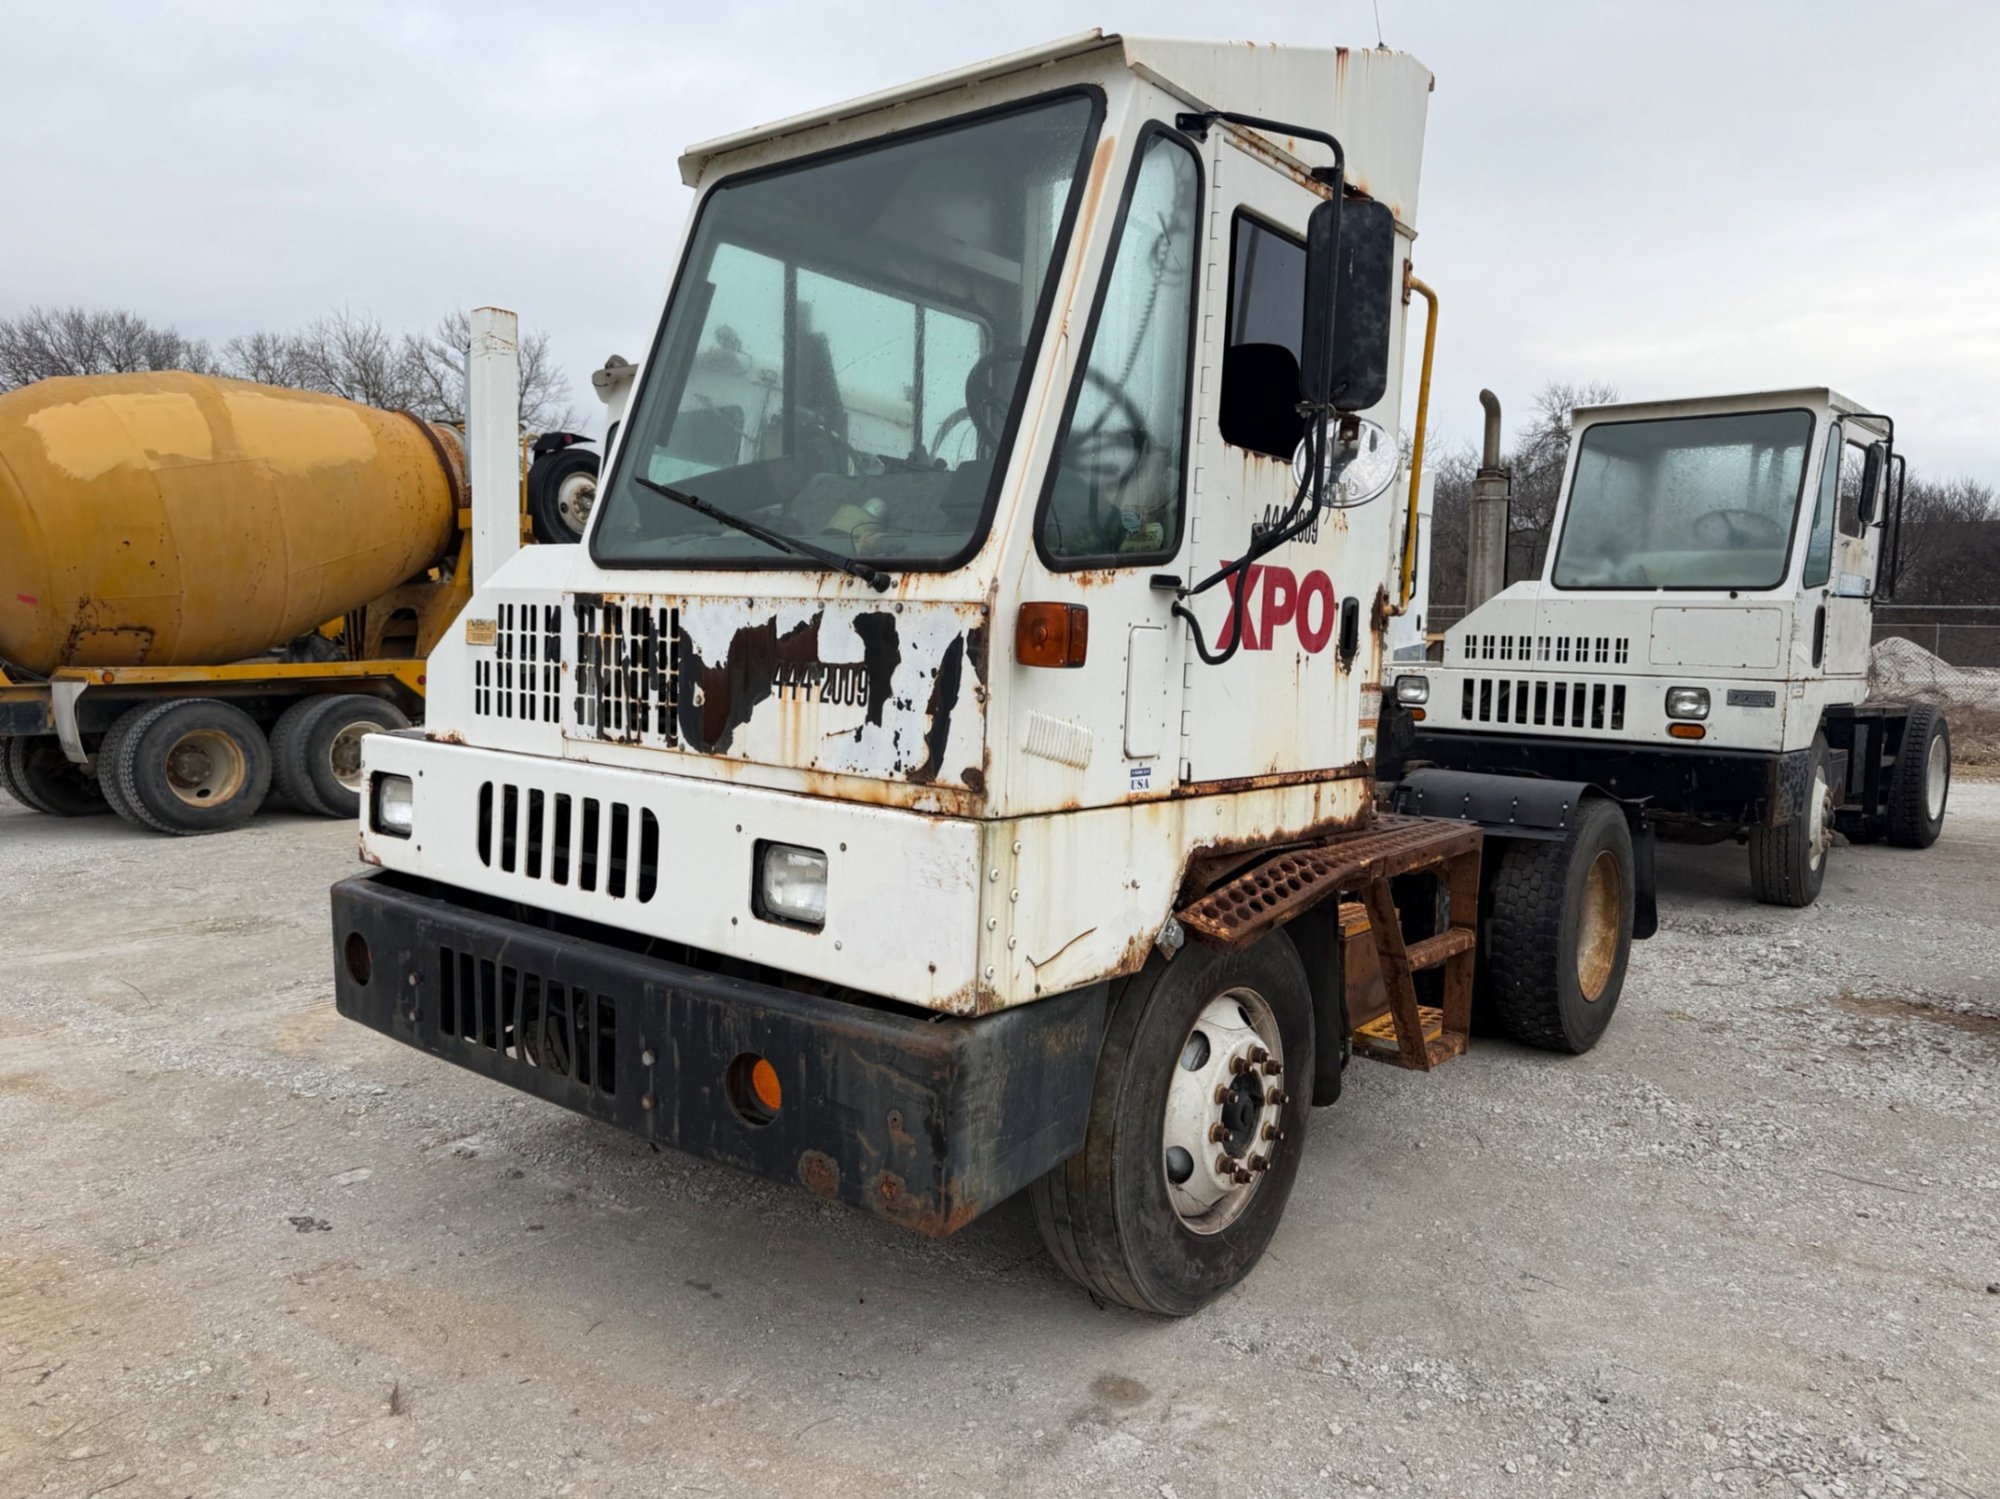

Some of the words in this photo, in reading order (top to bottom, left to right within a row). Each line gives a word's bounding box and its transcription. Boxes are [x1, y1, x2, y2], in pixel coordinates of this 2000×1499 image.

[1262, 504, 1319, 544] 44009
[1215, 560, 1335, 654] XPO
[772, 664, 869, 707] 444-2009
[1130, 778, 1149, 791] USA
